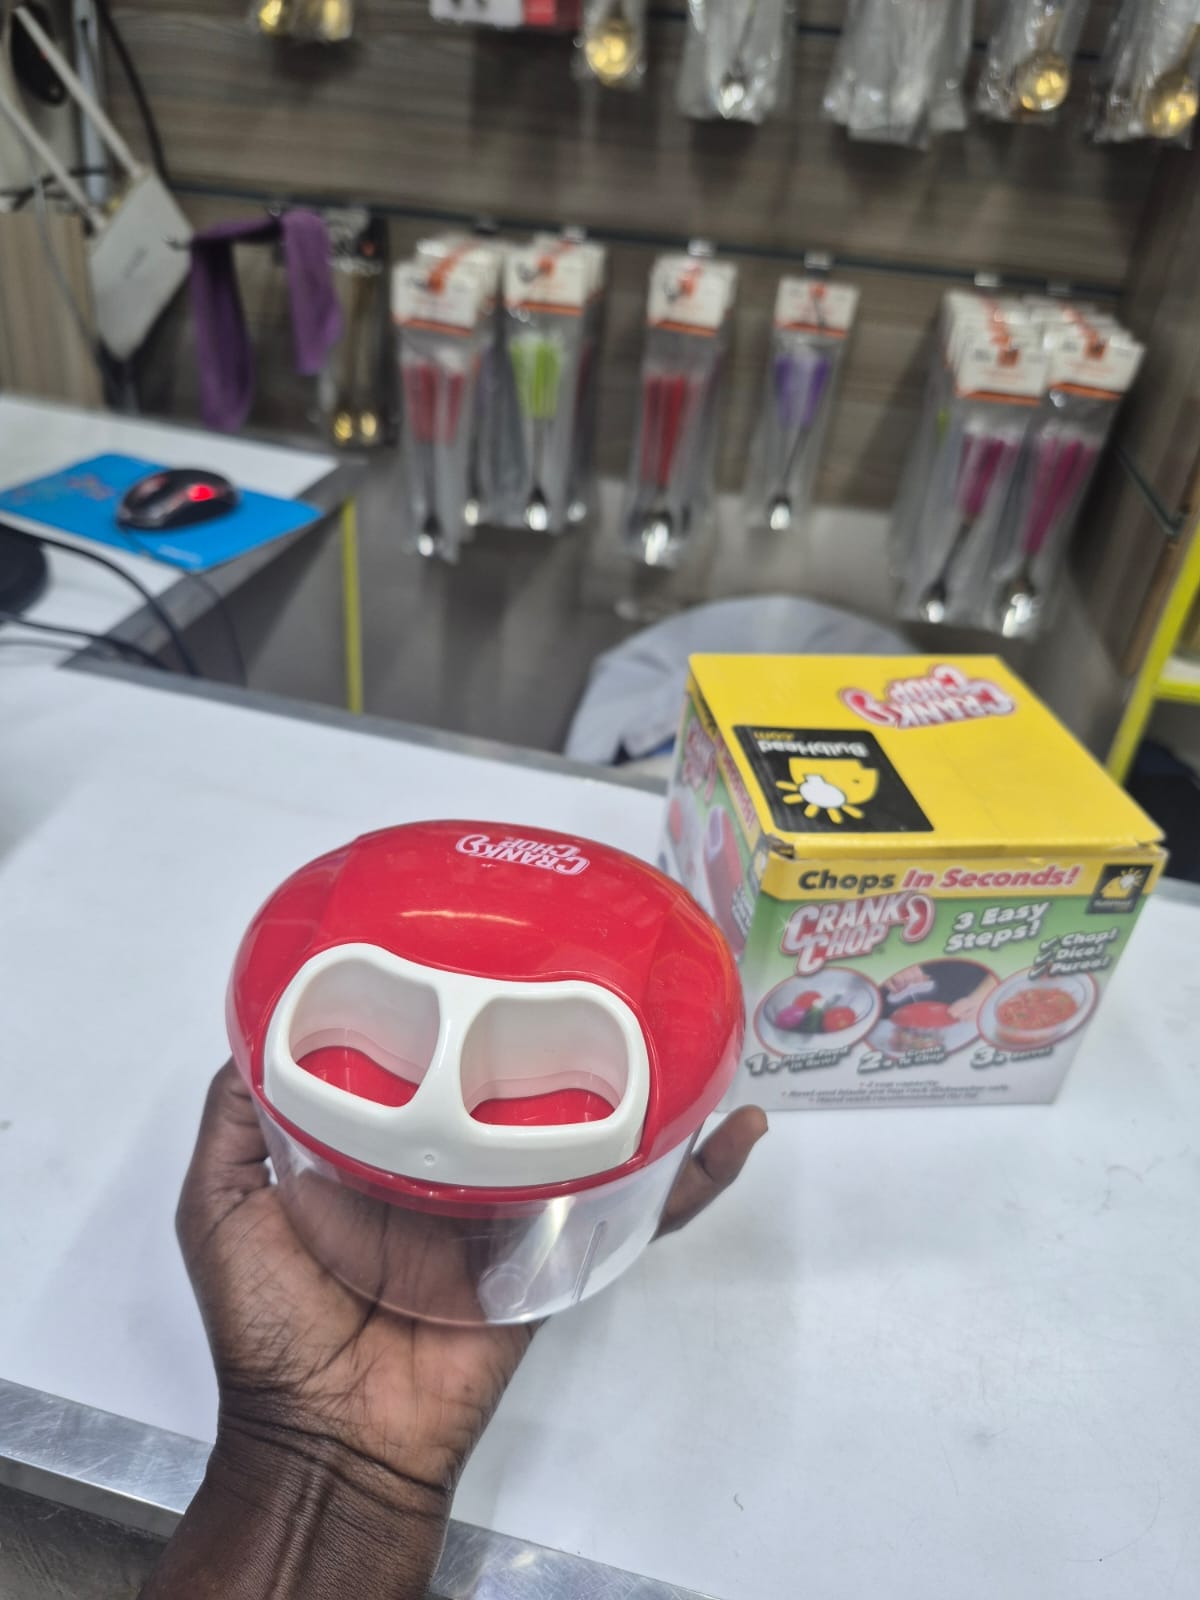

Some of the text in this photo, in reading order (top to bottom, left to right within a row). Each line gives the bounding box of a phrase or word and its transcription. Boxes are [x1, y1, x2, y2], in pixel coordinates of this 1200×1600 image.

[889, 664, 966, 702] CHOP
[868, 681, 1014, 729] CRANK
[758, 740, 868, 757] BulbHead
[466, 840, 589, 875] CRANK
[499, 838, 581, 858] CHOP
[799, 865, 1081, 893] Chops In Seconds!
[783, 892, 924, 951] CRANK
[954, 902, 1050, 931] 3 Easy
[798, 922, 890, 975] CHOP
[945, 919, 1041, 953] Steps!
